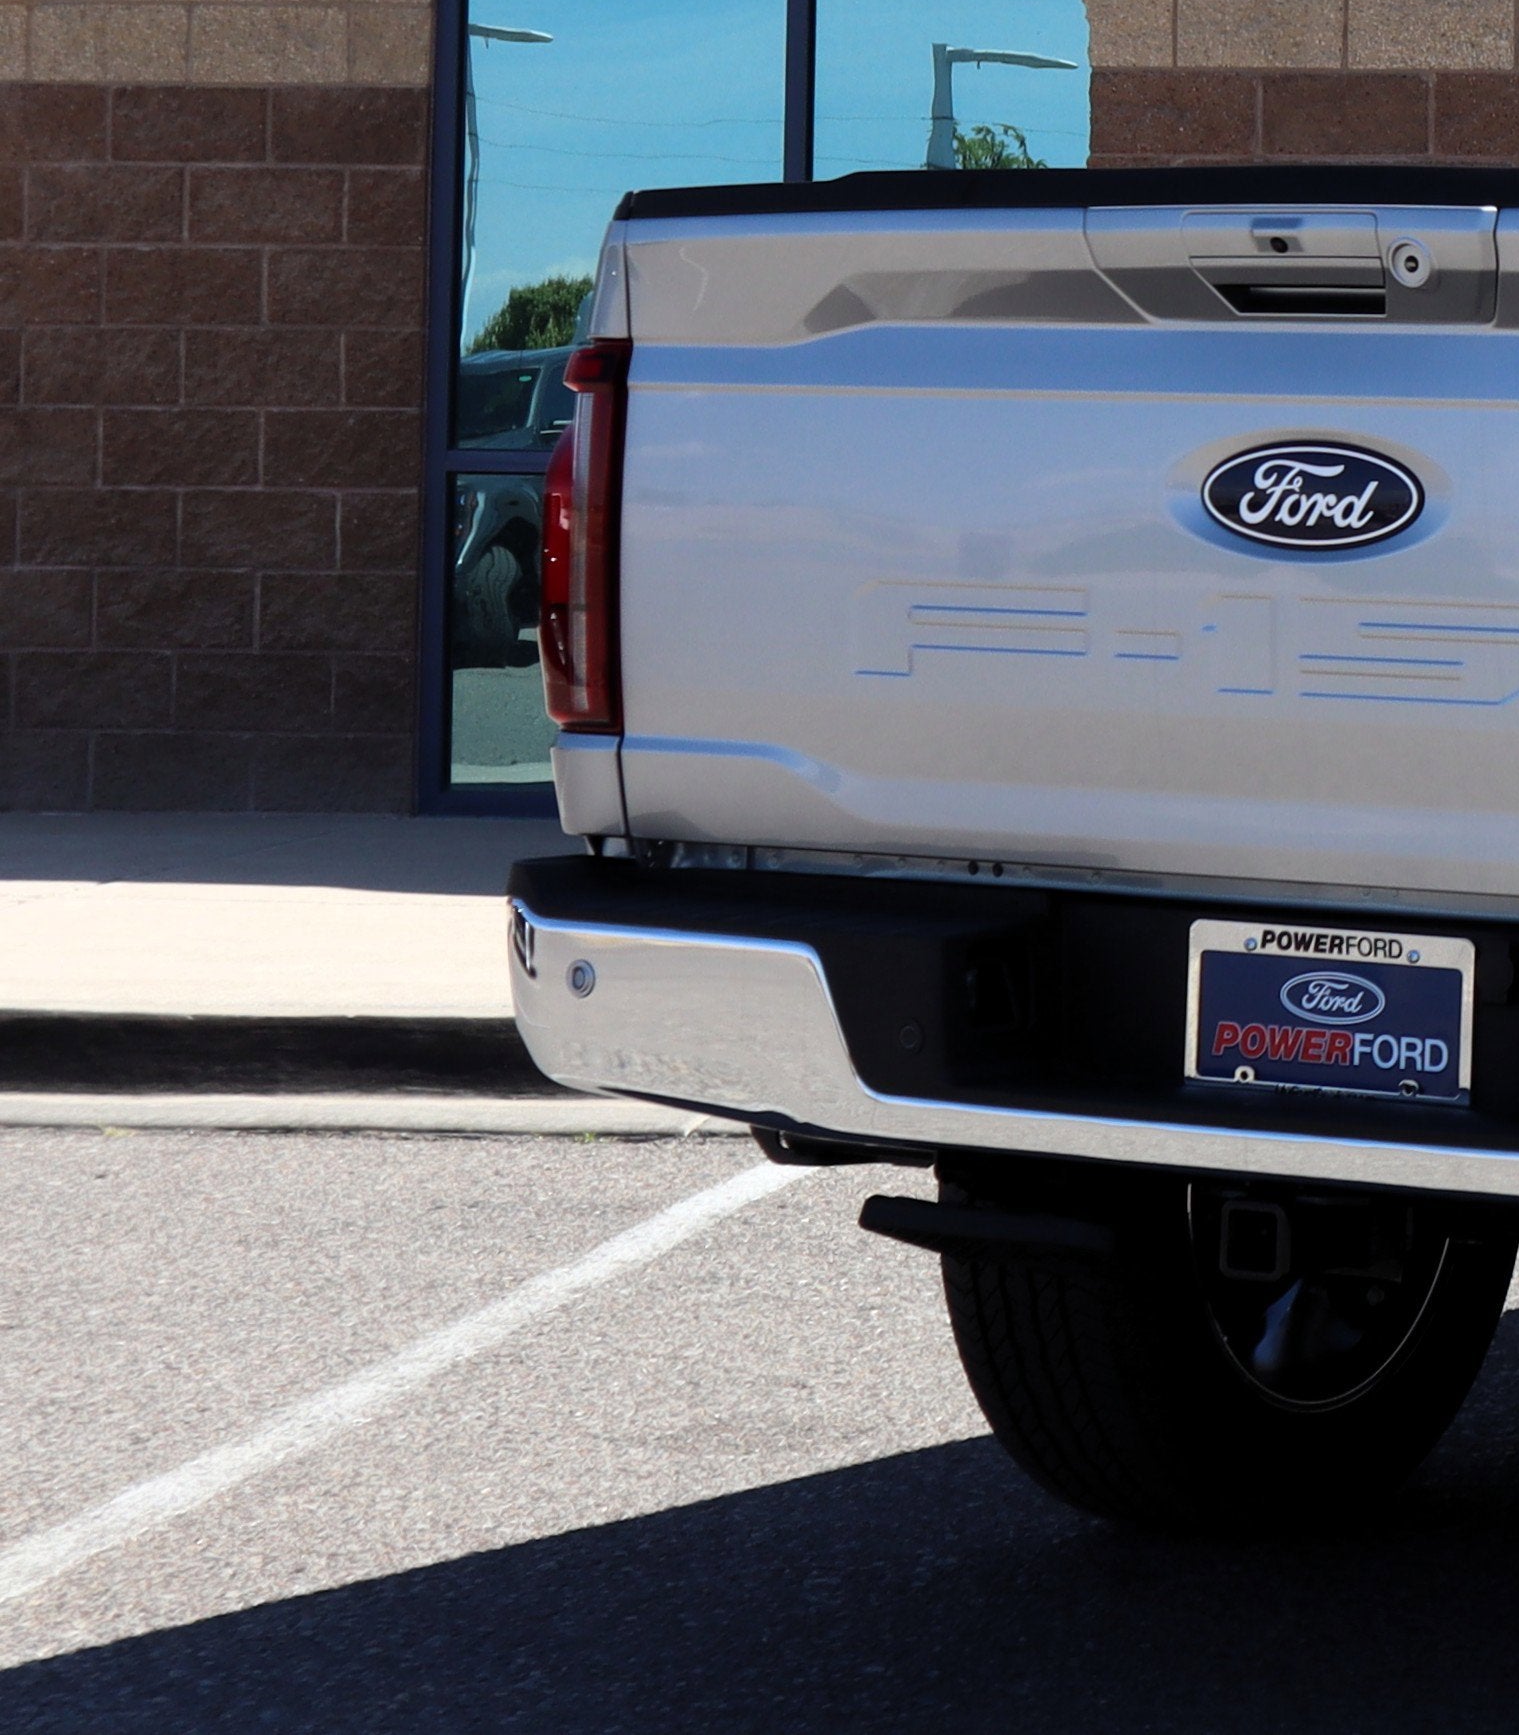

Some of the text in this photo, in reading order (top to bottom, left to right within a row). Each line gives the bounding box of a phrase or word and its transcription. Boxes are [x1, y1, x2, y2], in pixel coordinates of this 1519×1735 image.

[1239, 458, 1379, 529] Ford
[1260, 929, 1403, 959] POWERFORD
[1301, 980, 1363, 1014] Ford
